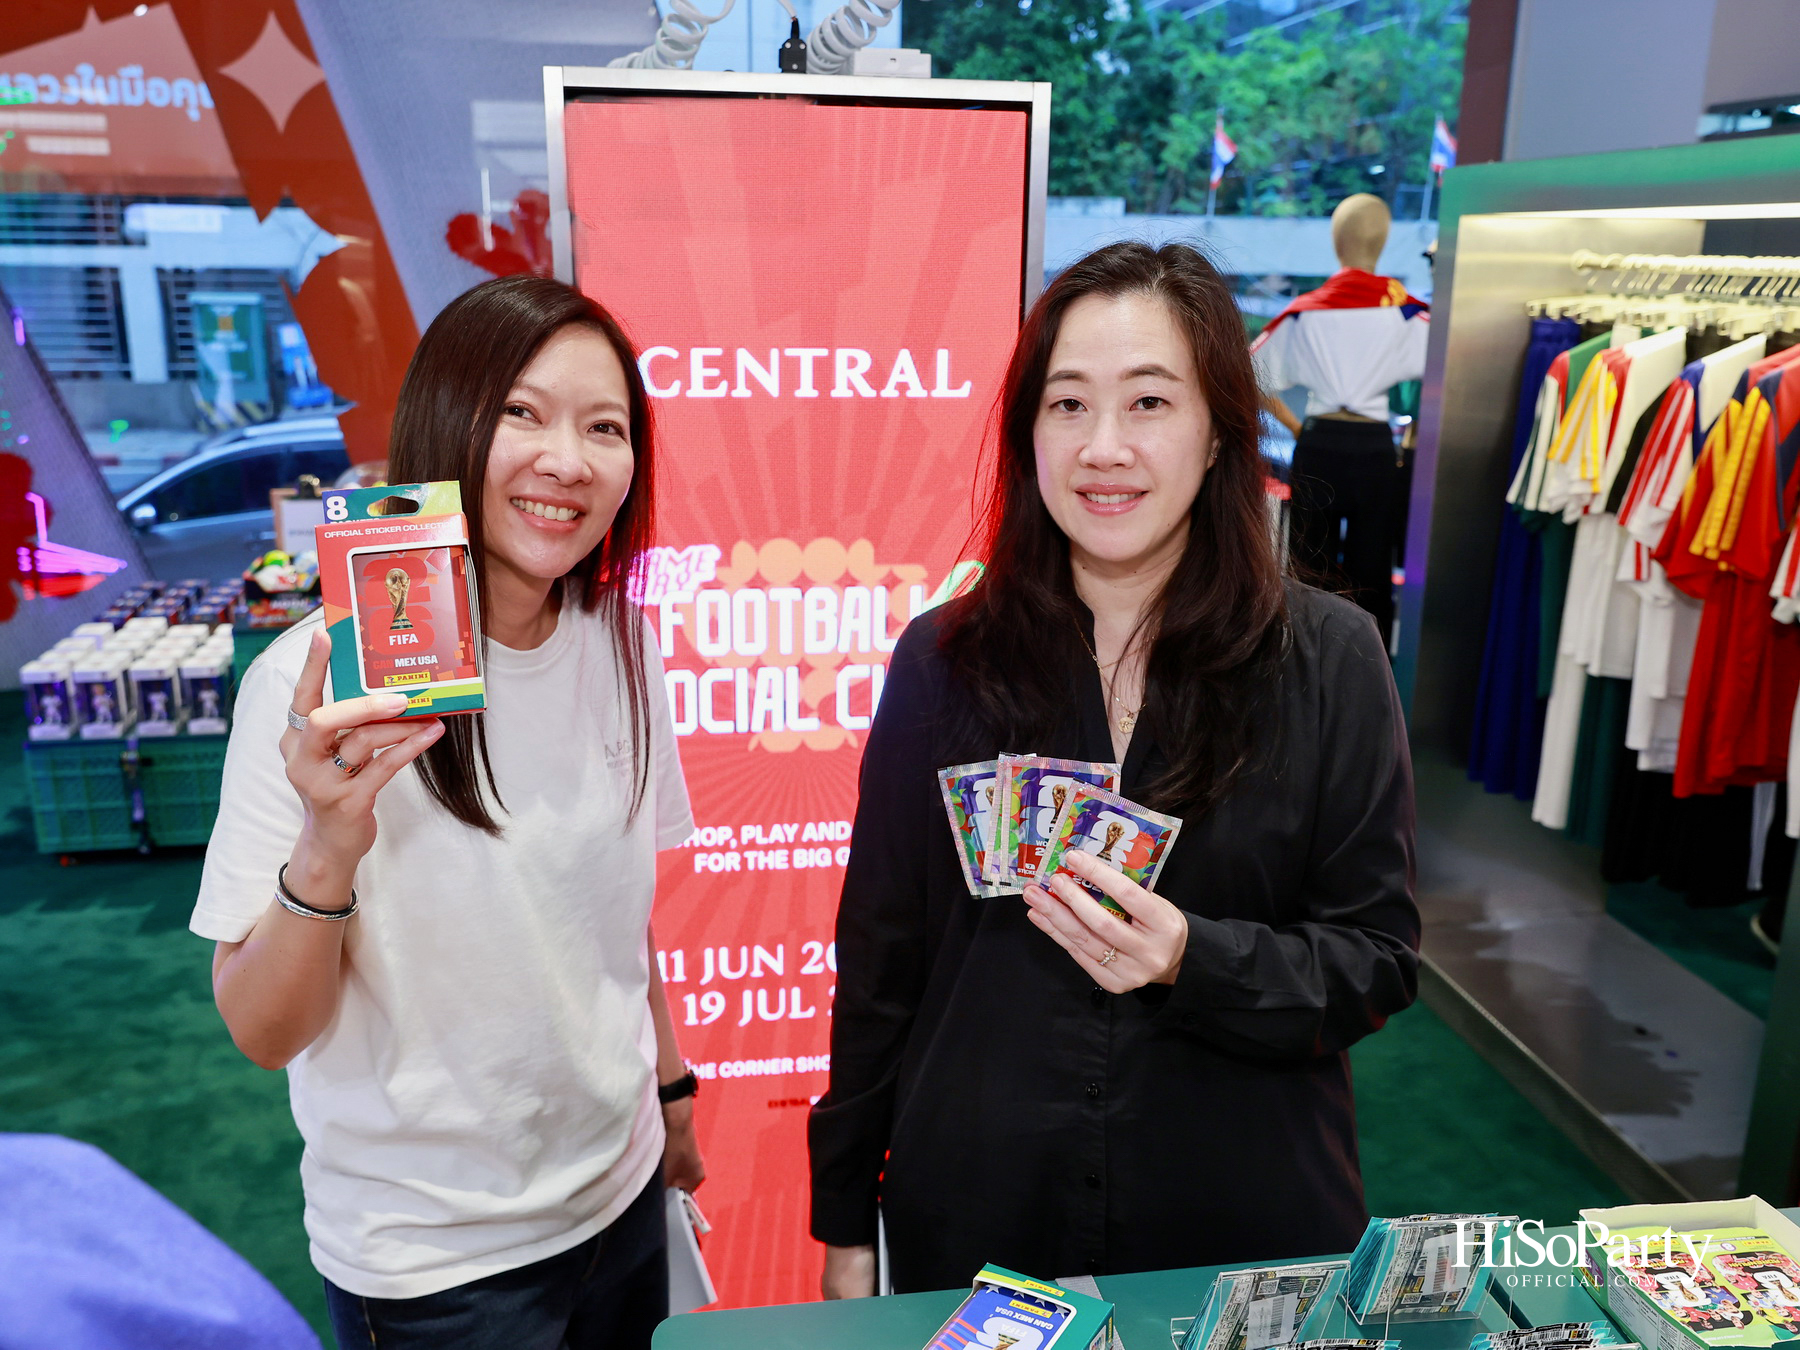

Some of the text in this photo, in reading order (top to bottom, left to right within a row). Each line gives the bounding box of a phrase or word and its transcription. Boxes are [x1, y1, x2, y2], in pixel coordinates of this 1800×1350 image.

[637, 346, 972, 399] CENTRAL
[326, 495, 349, 521] 8
[324, 529, 364, 539] OFFICIAL
[365, 525, 402, 536] STICKER
[402, 522, 449, 532] COLLECT
[388, 633, 419, 646] FIFA
[394, 657, 416, 668] MEX
[417, 655, 438, 666] USA
[397, 673, 429, 681] PANINI
[407, 697, 431, 705] NINI
[663, 666, 821, 736] OCIAL
[676, 820, 852, 849] HOP, PLAY AND
[694, 846, 851, 874] FOR THE BIG G
[656, 949, 687, 983] 11
[699, 944, 784, 986] JUN
[682, 990, 726, 1026] 19
[738, 986, 816, 1028] JUL
[688, 1054, 831, 1080] HE CORNER SHO
[995, 1306, 1054, 1330] CAN MEX USA
